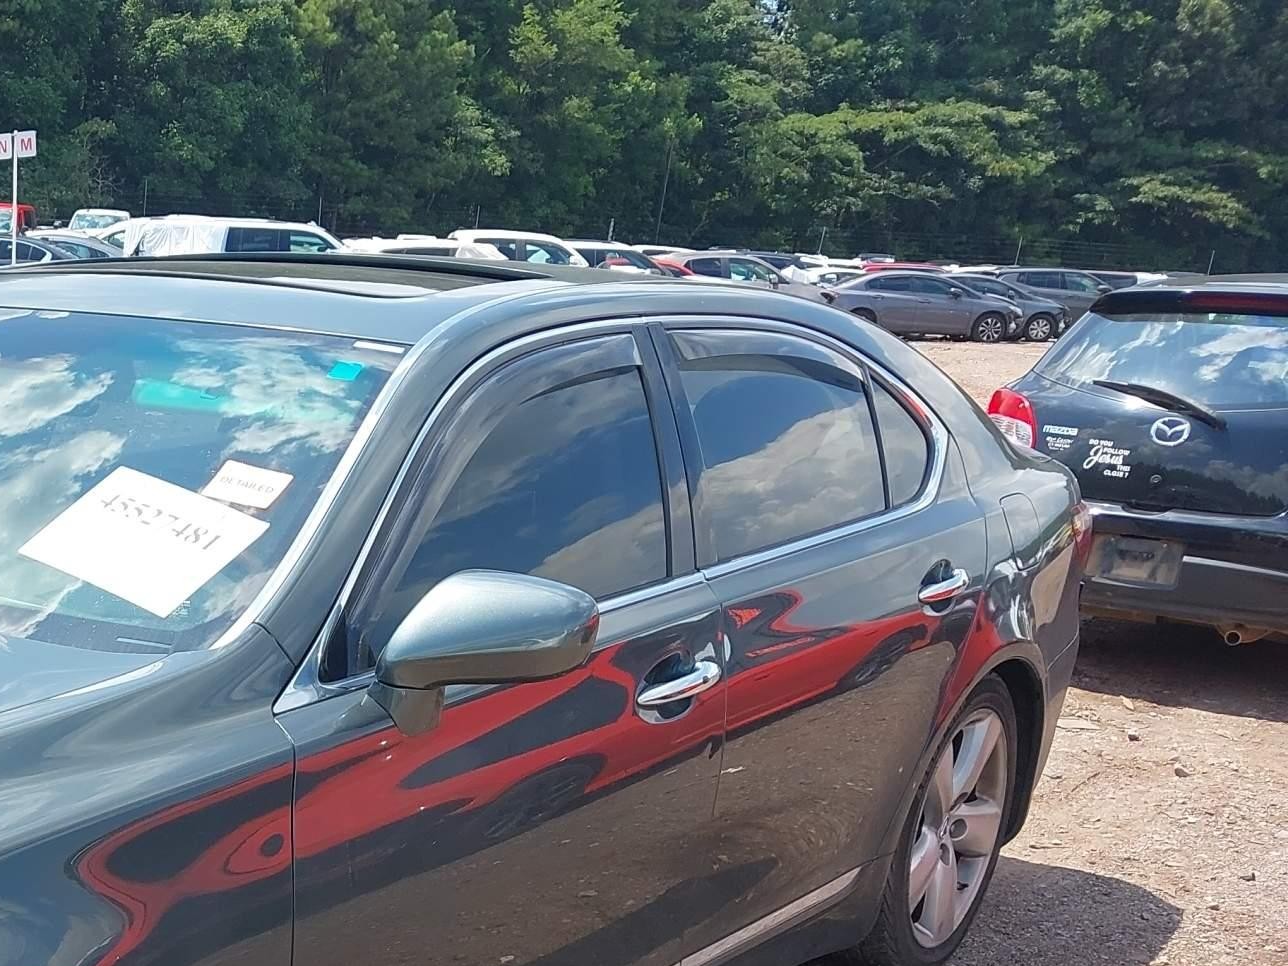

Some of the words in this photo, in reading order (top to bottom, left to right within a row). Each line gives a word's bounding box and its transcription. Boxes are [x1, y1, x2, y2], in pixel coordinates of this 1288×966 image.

[20, 137, 33, 152] M
[1099, 439, 1114, 447] YOU
[1082, 445, 1124, 469] Jesus
[1102, 447, 1131, 456] FOLLOW
[1103, 470, 1124, 478] CLOSE
[100, 494, 222, 550] 45527481
